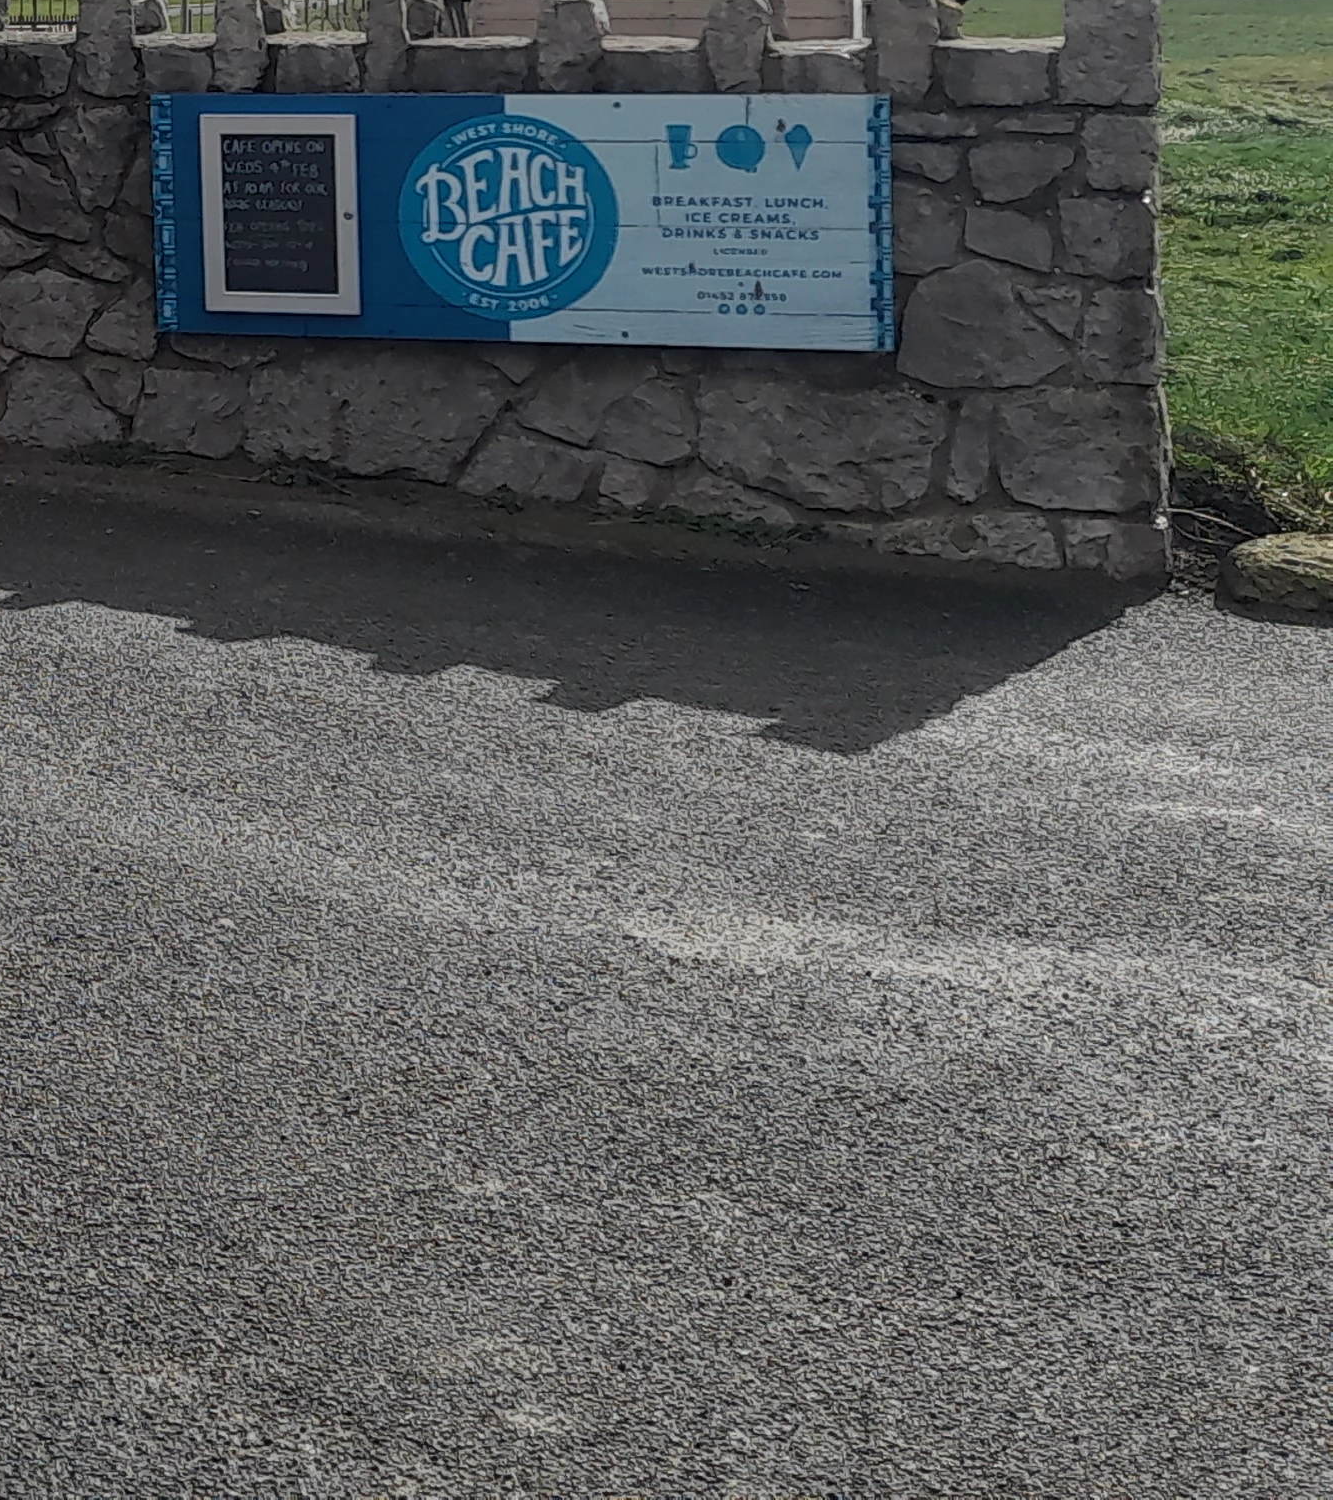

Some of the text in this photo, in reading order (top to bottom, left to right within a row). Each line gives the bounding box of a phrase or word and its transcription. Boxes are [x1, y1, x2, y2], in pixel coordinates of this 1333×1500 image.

[451, 122, 559, 146] WEST SHORE
[416, 147, 587, 243] BEACH
[685, 212, 797, 226] ICE CREAMS,
[661, 227, 728, 240] DRINKS
[750, 229, 820, 241] SNACKS
[459, 209, 587, 287] CAFE
[469, 293, 501, 311] EST
